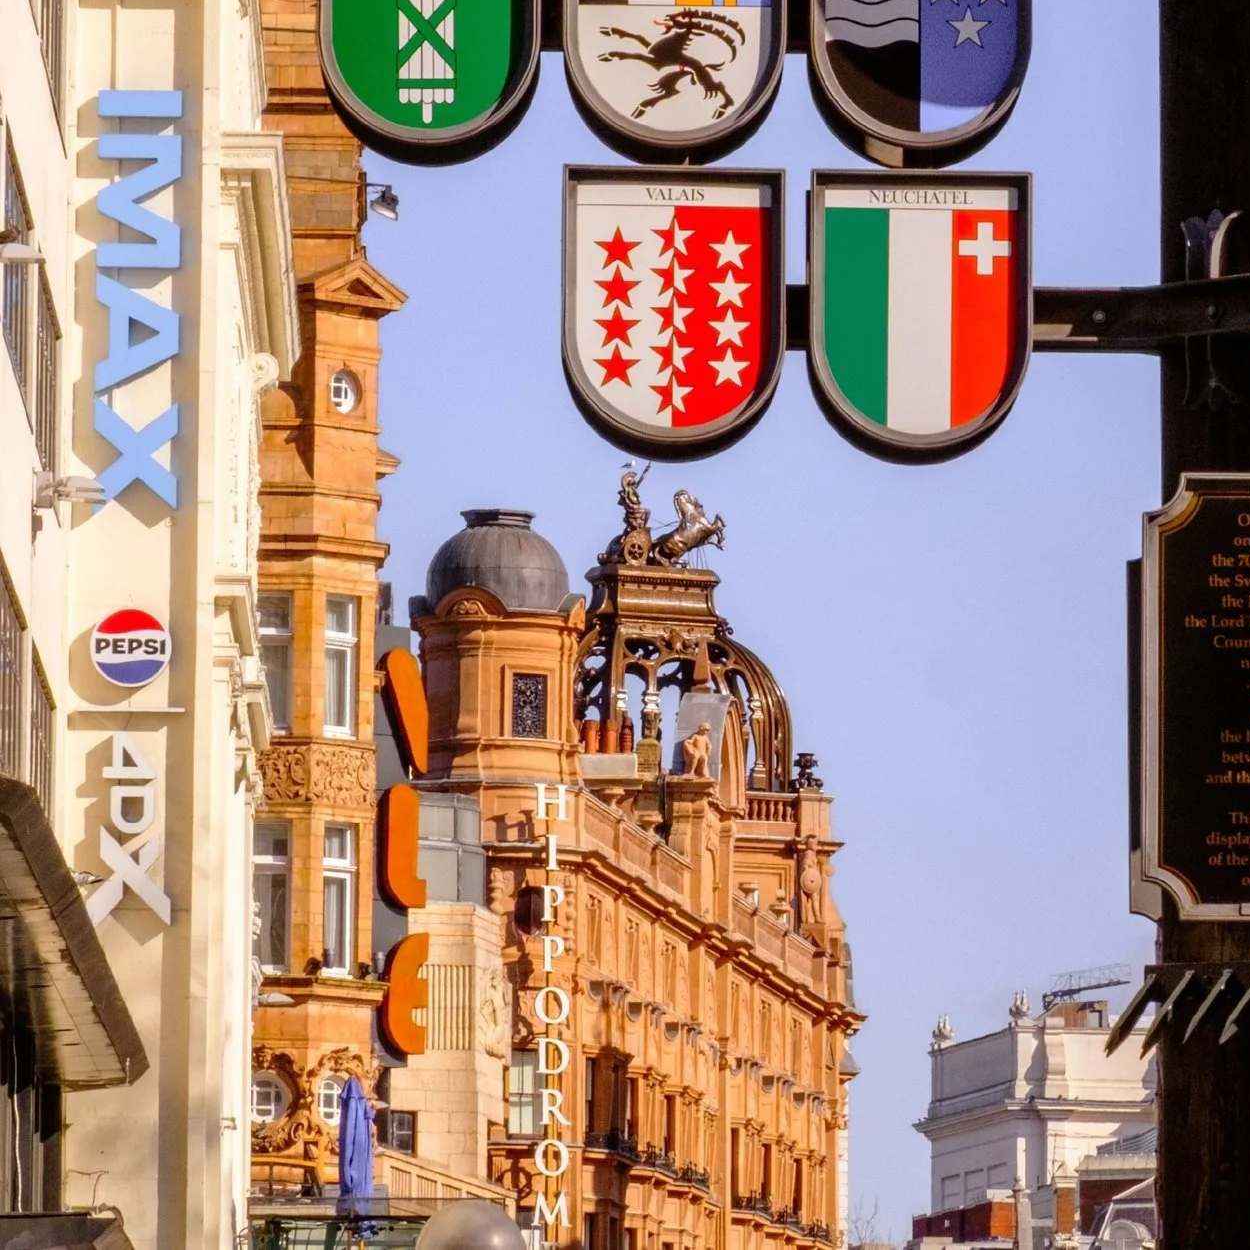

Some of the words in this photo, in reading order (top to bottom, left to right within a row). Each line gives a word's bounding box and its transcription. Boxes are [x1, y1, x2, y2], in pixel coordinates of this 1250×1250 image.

[646, 187, 705, 201] VALAIS
[92, 90, 182, 512] IMAX
[1212, 553, 1235, 567] the
[1208, 574, 1231, 588] the
[1222, 594, 1244, 608] the
[1184, 614, 1207, 628] the
[1211, 614, 1245, 628] Lord
[95, 638, 166, 654] PEPSI
[1220, 730, 1242, 743] the
[1206, 770, 1233, 783] and
[85, 732, 171, 927] 4DX
[1208, 852, 1223, 866] of
[1226, 852, 1249, 865] the
[531, 783, 572, 1250] HIPPODROM
